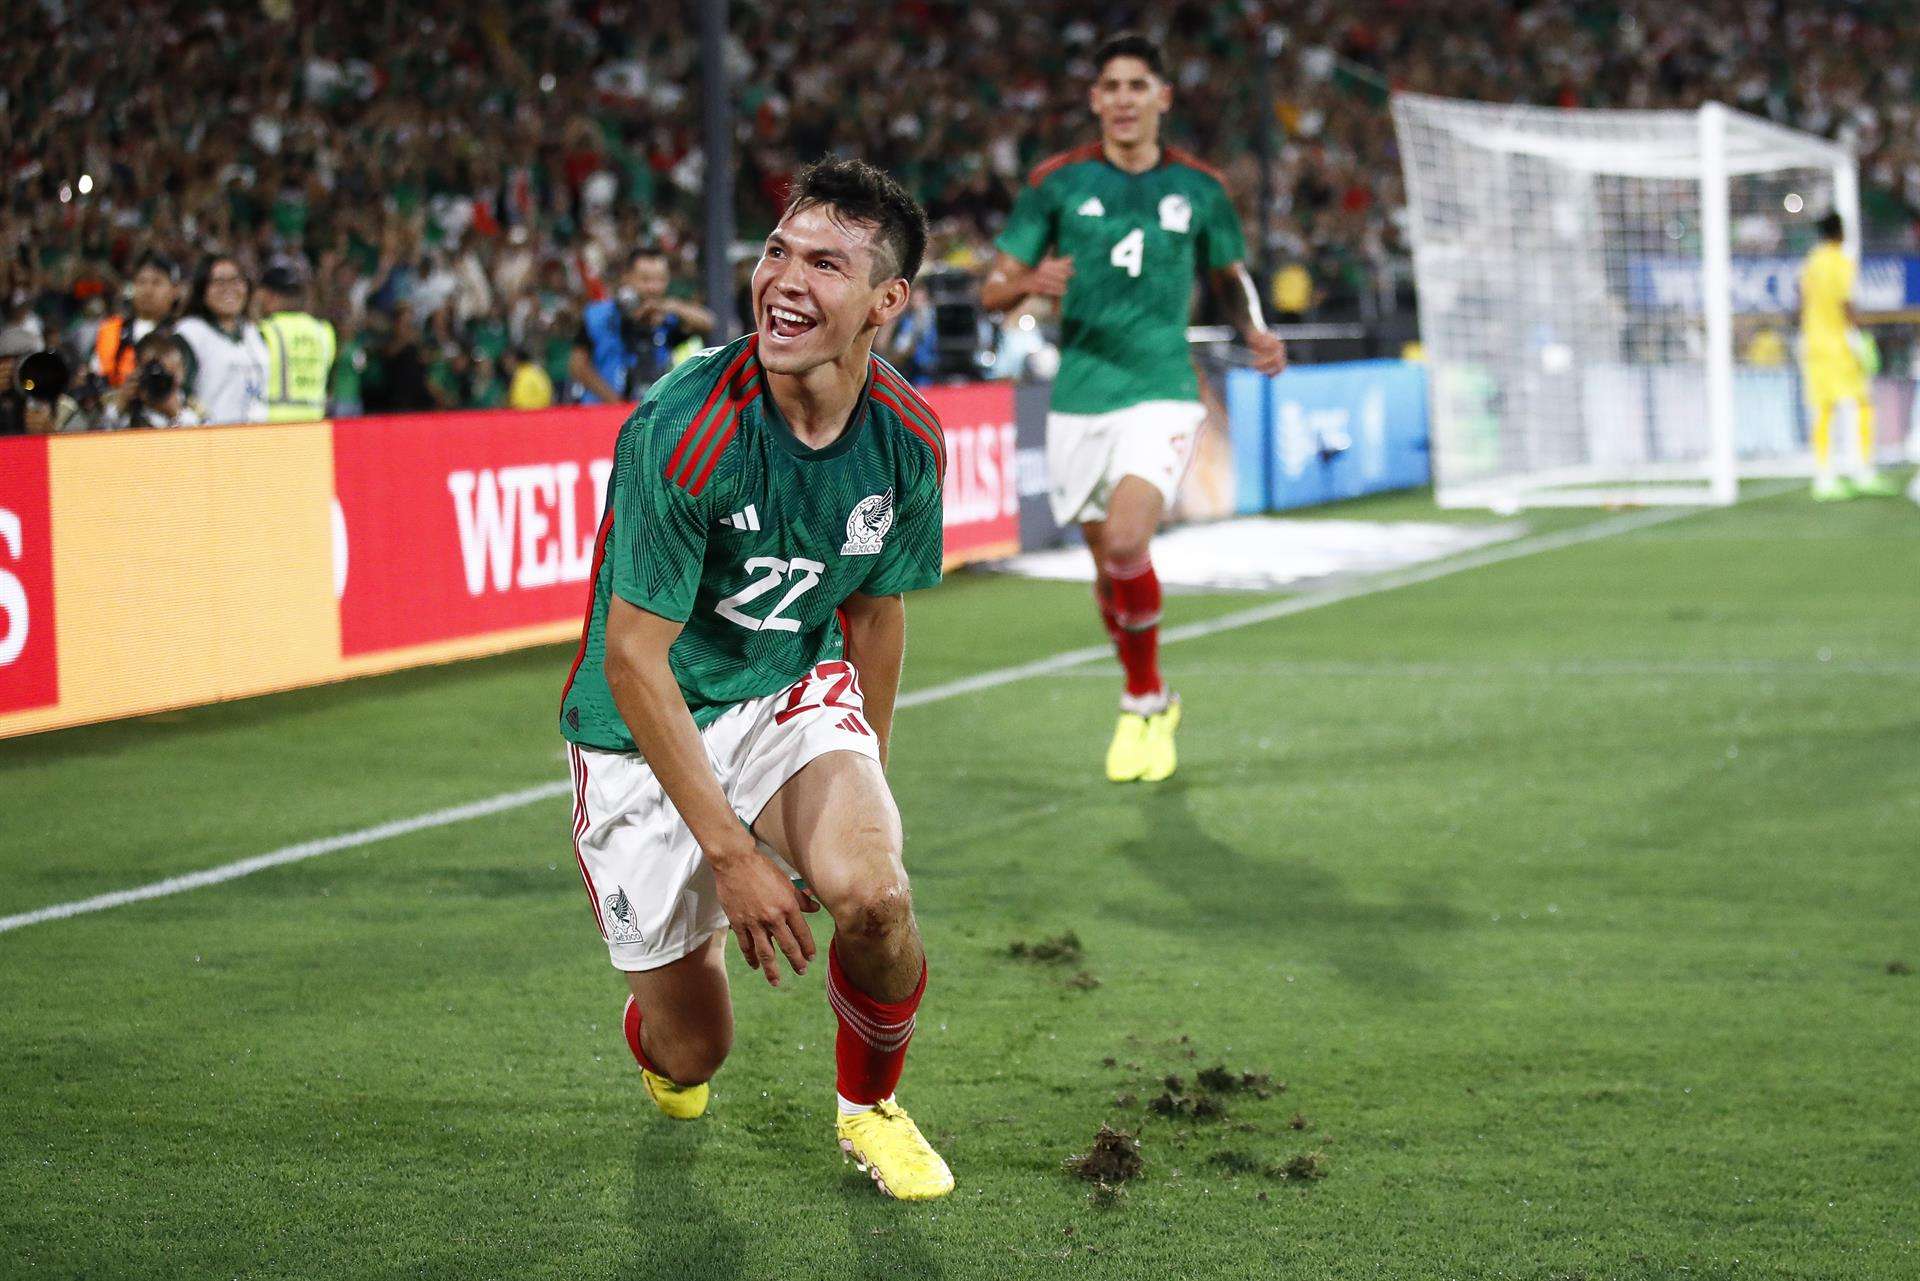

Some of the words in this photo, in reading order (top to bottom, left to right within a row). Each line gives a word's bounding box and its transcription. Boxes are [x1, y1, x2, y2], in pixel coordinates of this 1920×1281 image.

[1110, 228, 1145, 278] 4
[714, 556, 826, 633] 22
[774, 661, 861, 726] 22
